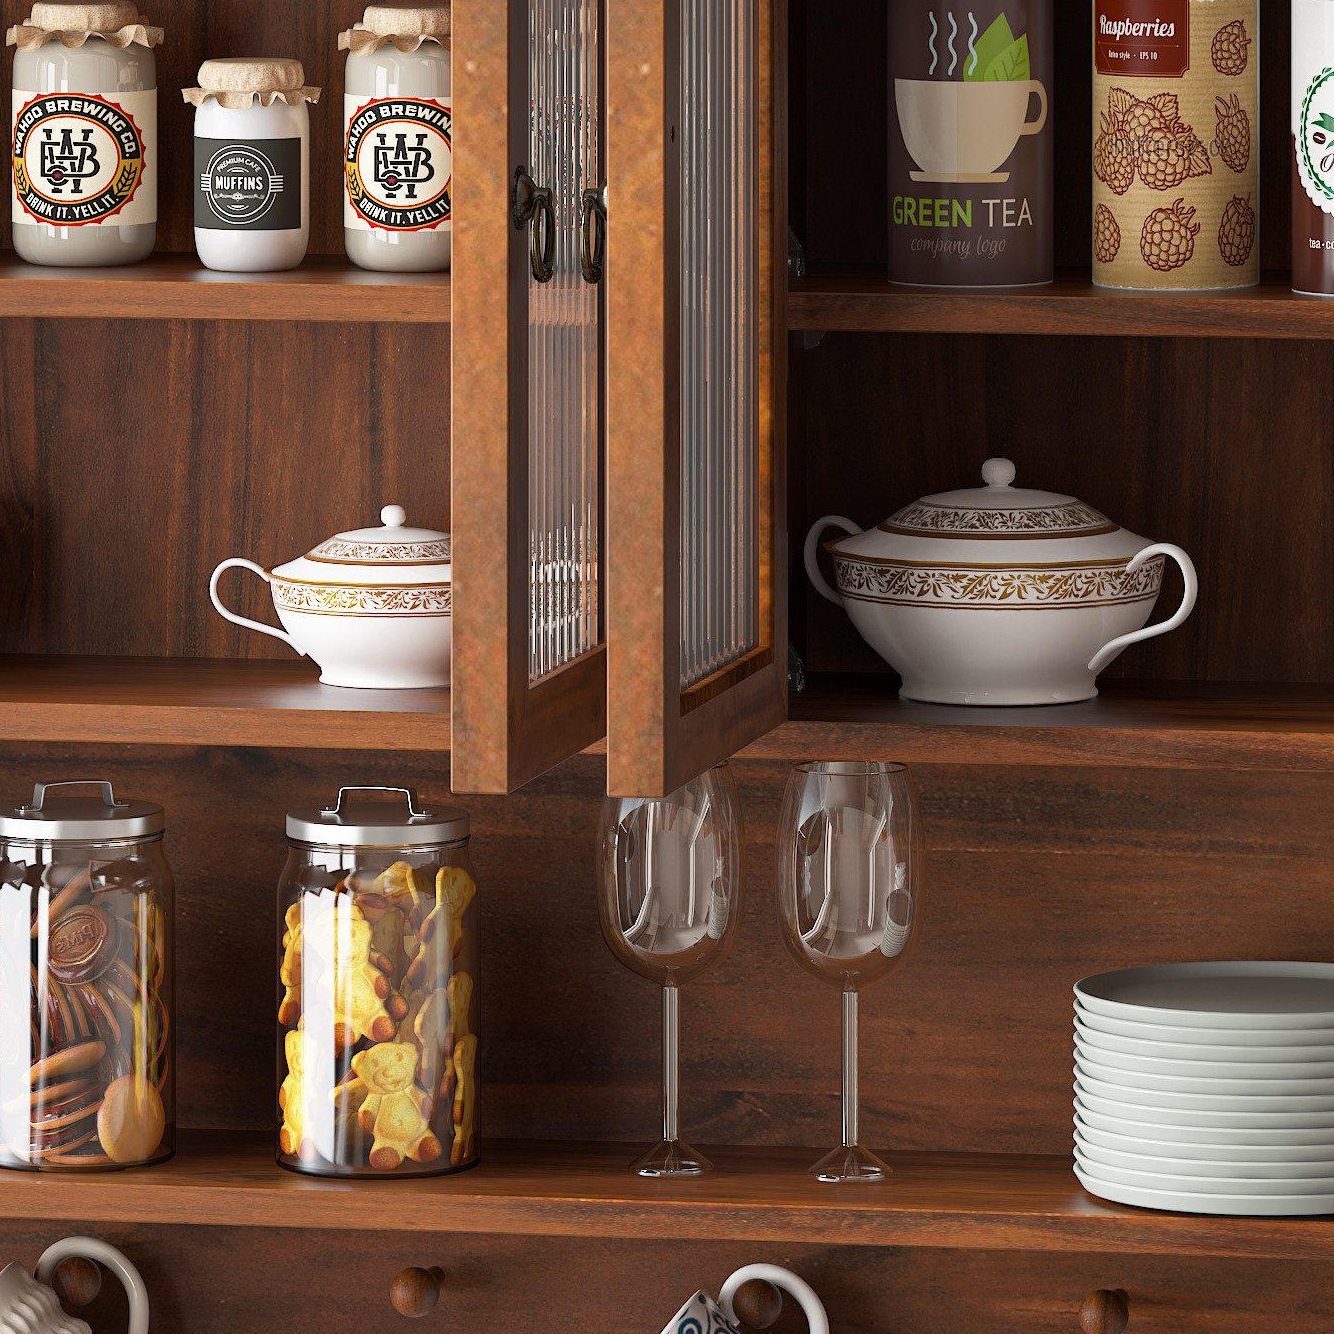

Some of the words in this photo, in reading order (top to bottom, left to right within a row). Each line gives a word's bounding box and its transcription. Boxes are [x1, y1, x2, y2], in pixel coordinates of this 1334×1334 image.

[1100, 14, 1175, 41] Raspberries
[1119, 51, 1130, 61] style
[1139, 51, 1149, 60] EPS
[1151, 51, 1158, 60] 10
[15, 106, 43, 154] WAHOO
[45, 99, 127, 134] BREWING
[347, 110, 377, 159] WAHOO
[216, 157, 245, 172] PREMIUM
[245, 158, 261, 172] CAFE
[215, 175, 263, 190] MUFFINS
[26, 193, 55, 217] DRINK
[72, 201, 105, 219] YELL
[359, 197, 389, 222] DRINK
[406, 205, 439, 224] YELL
[892, 195, 972, 228] GREEN
[981, 197, 1033, 227] TEA
[910, 236, 971, 260] company
[976, 234, 1007, 260] logo
